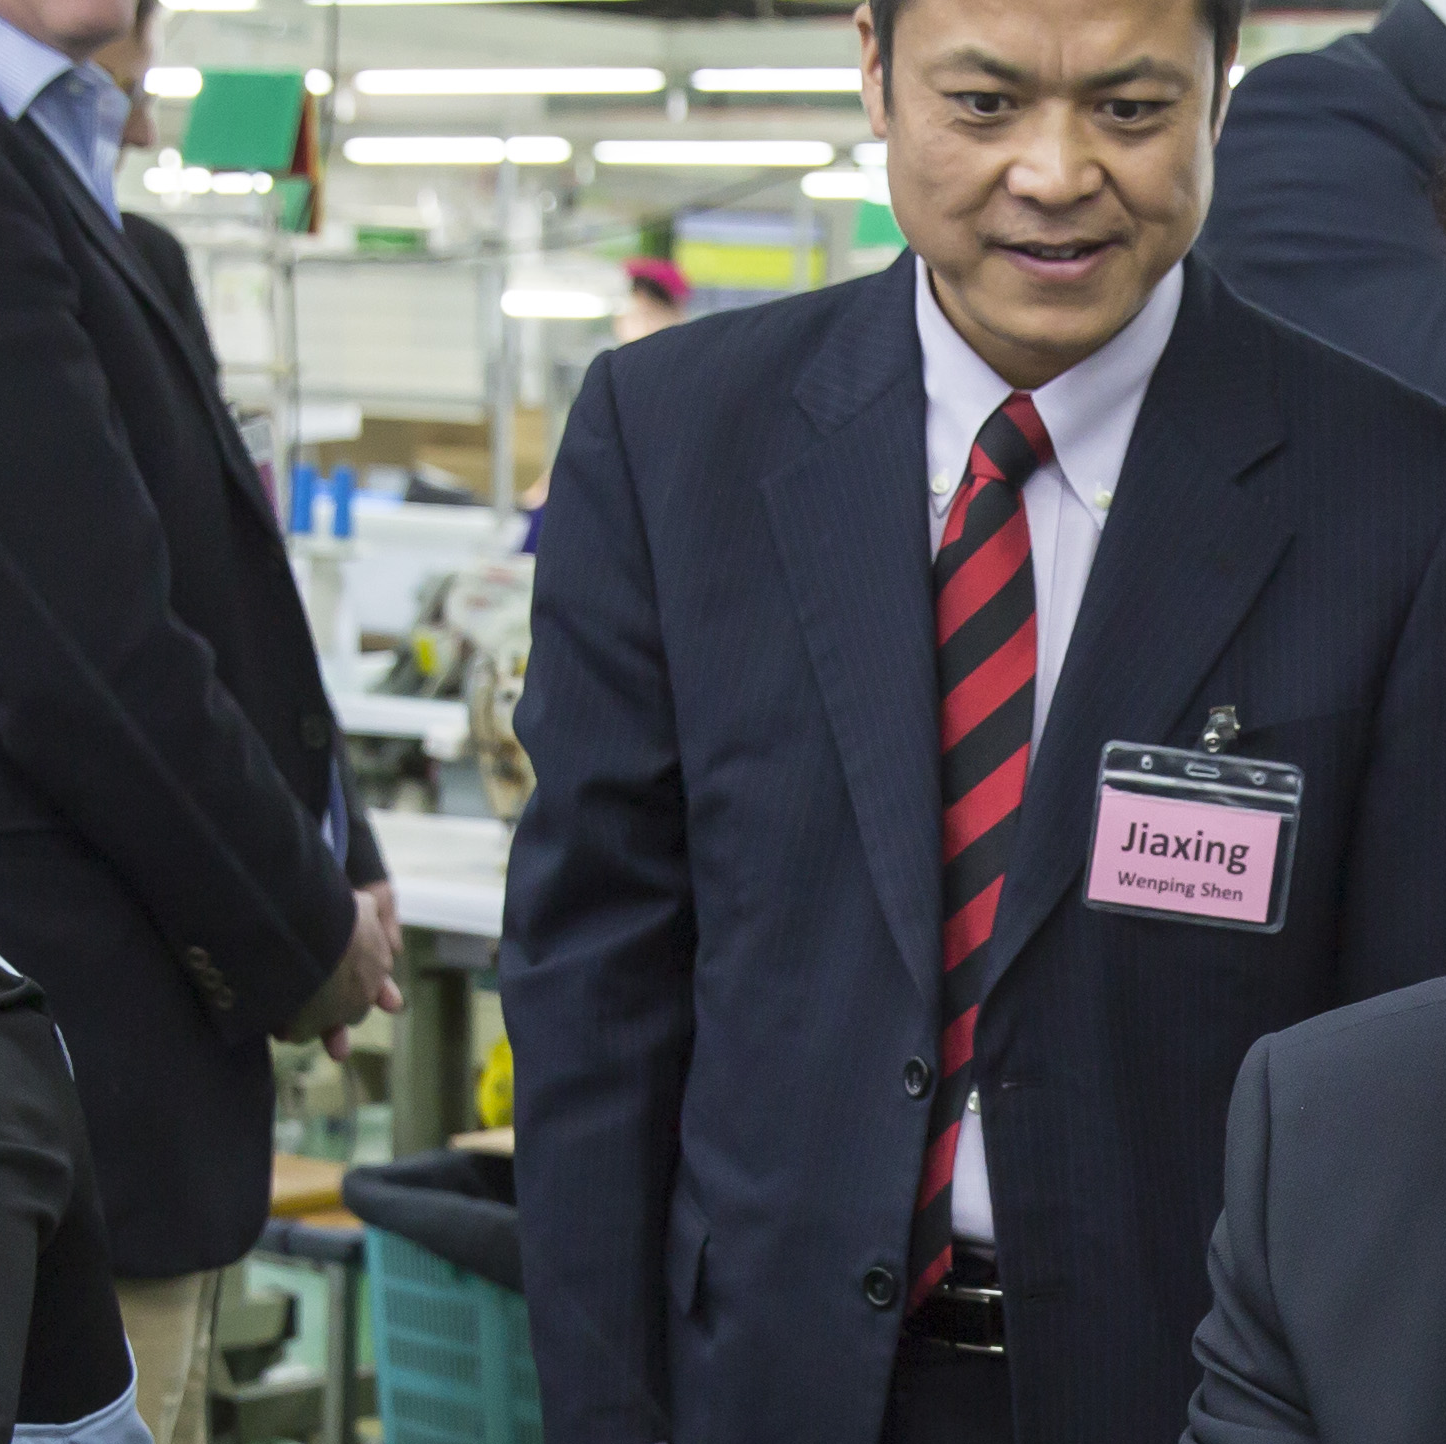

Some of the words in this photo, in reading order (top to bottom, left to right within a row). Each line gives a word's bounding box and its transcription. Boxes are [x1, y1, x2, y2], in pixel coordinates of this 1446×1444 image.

[1121, 821, 1250, 875] Jiaxing
[1117, 870, 1196, 898] Wenping
[1200, 882, 1243, 901] Shen
